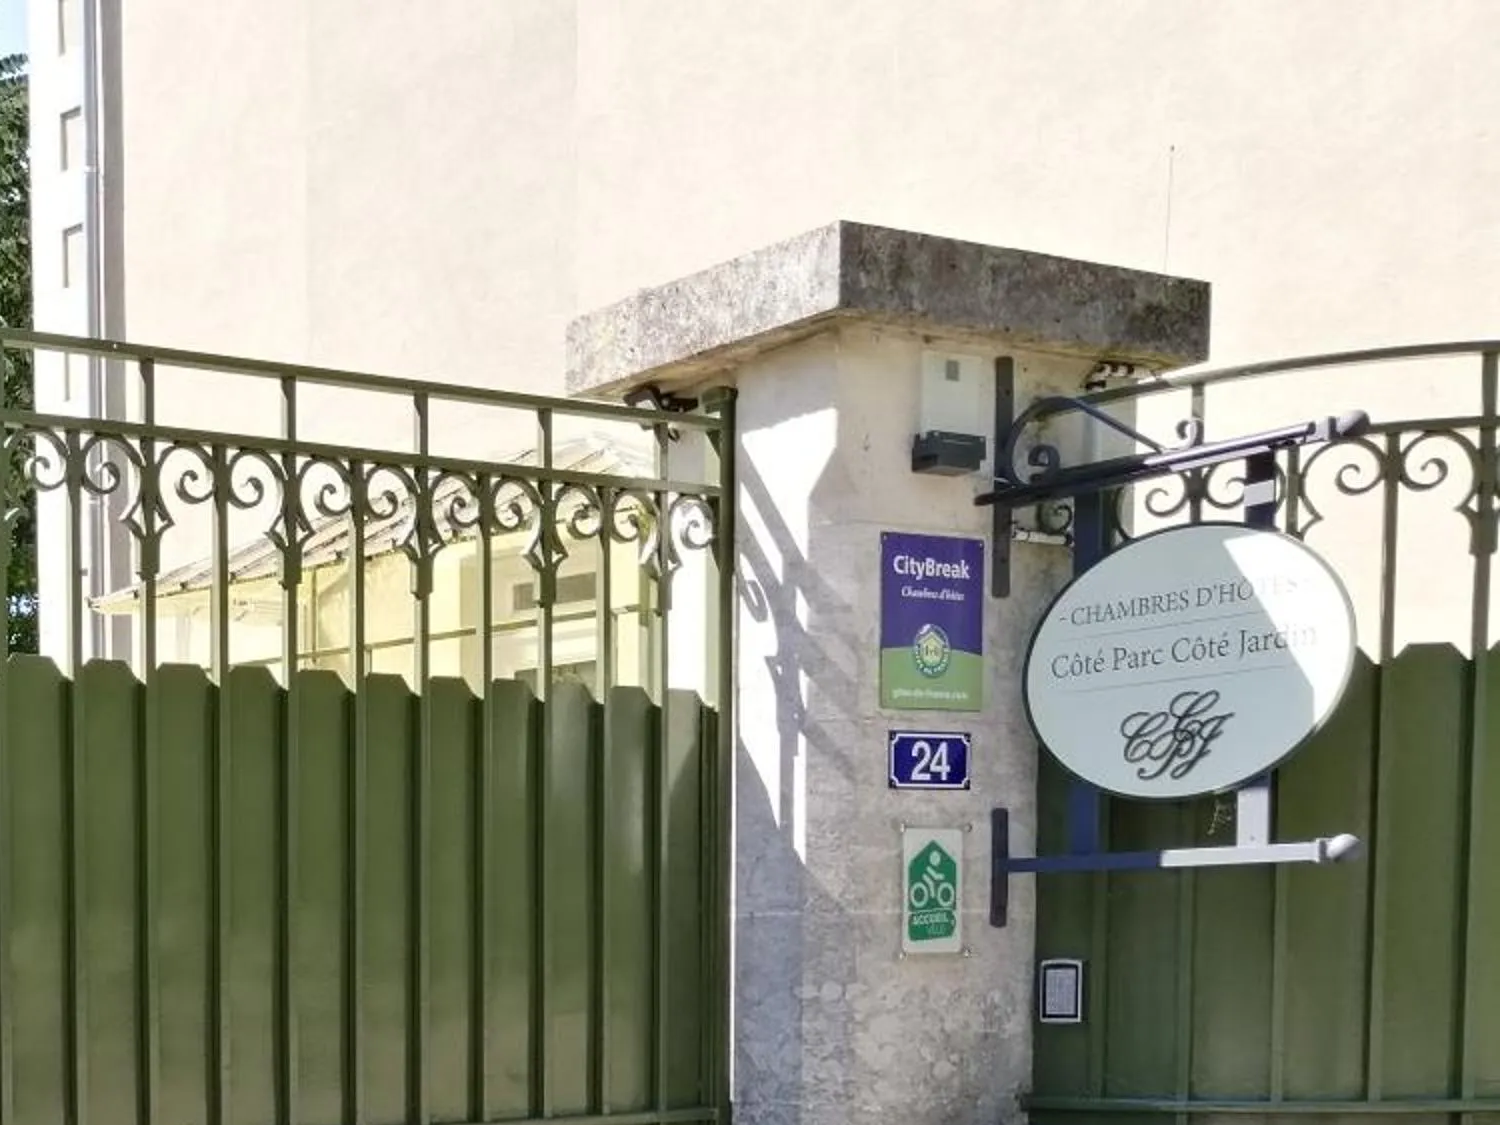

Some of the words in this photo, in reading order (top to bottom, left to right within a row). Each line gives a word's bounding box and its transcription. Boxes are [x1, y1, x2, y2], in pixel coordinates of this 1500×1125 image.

[893, 555, 970, 581] CityBreak
[1070, 590, 1189, 626] CHAMBRES
[1051, 647, 1106, 679] Côté
[1112, 646, 1165, 671] Parc
[1171, 631, 1229, 663] Côté
[911, 740, 950, 781] 24
